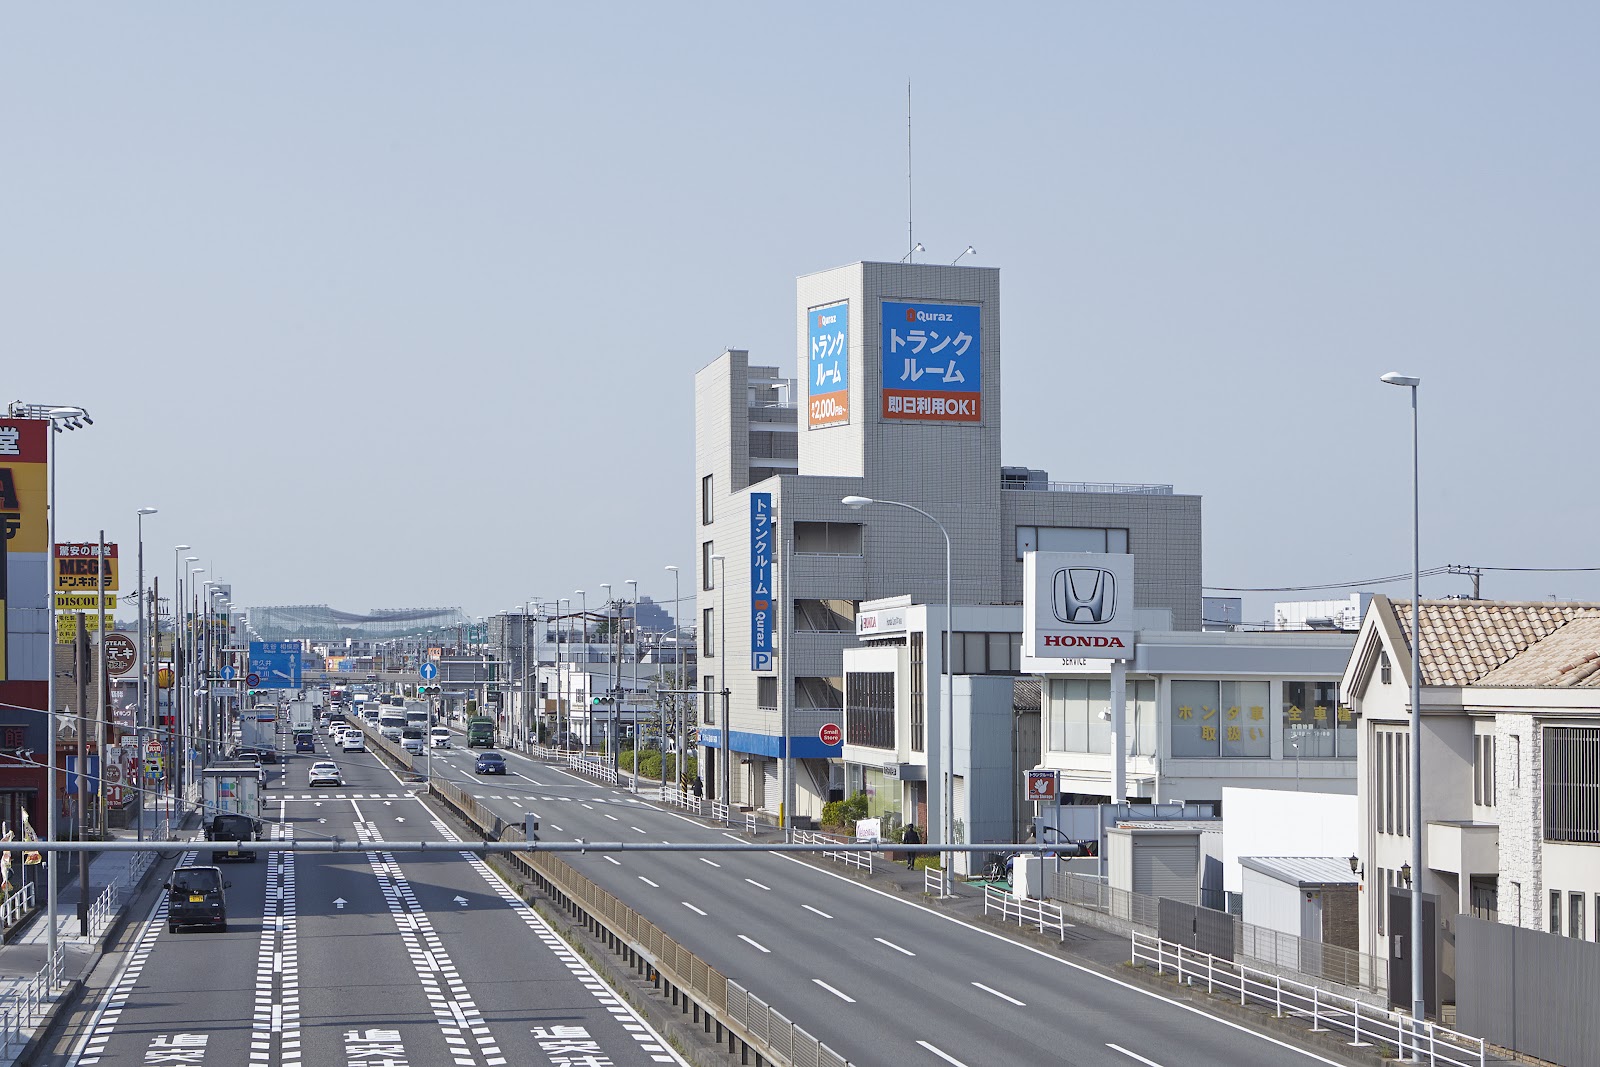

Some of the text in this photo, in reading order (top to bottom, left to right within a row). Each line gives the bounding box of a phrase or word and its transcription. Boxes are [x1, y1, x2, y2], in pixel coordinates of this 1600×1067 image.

[822, 315, 837, 326] Quraz
[916, 311, 953, 323] Quraz
[812, 331, 845, 361] トランク
[890, 328, 973, 356] トランク
[816, 361, 842, 387] ルーム
[900, 358, 966, 384] ルーム
[888, 396, 976, 415] 即日利用OK!
[755, 499, 768, 595] トランクルーム
[59, 559, 112, 575] MEGA
[57, 597, 114, 606] DISCOUT
[755, 611, 766, 648] Quraz
[1043, 635, 1126, 648] HONDA
[755, 653, 769, 669] P
[1178, 705, 1265, 721] ホンダ車
[1201, 725, 1265, 741] 取扱い
